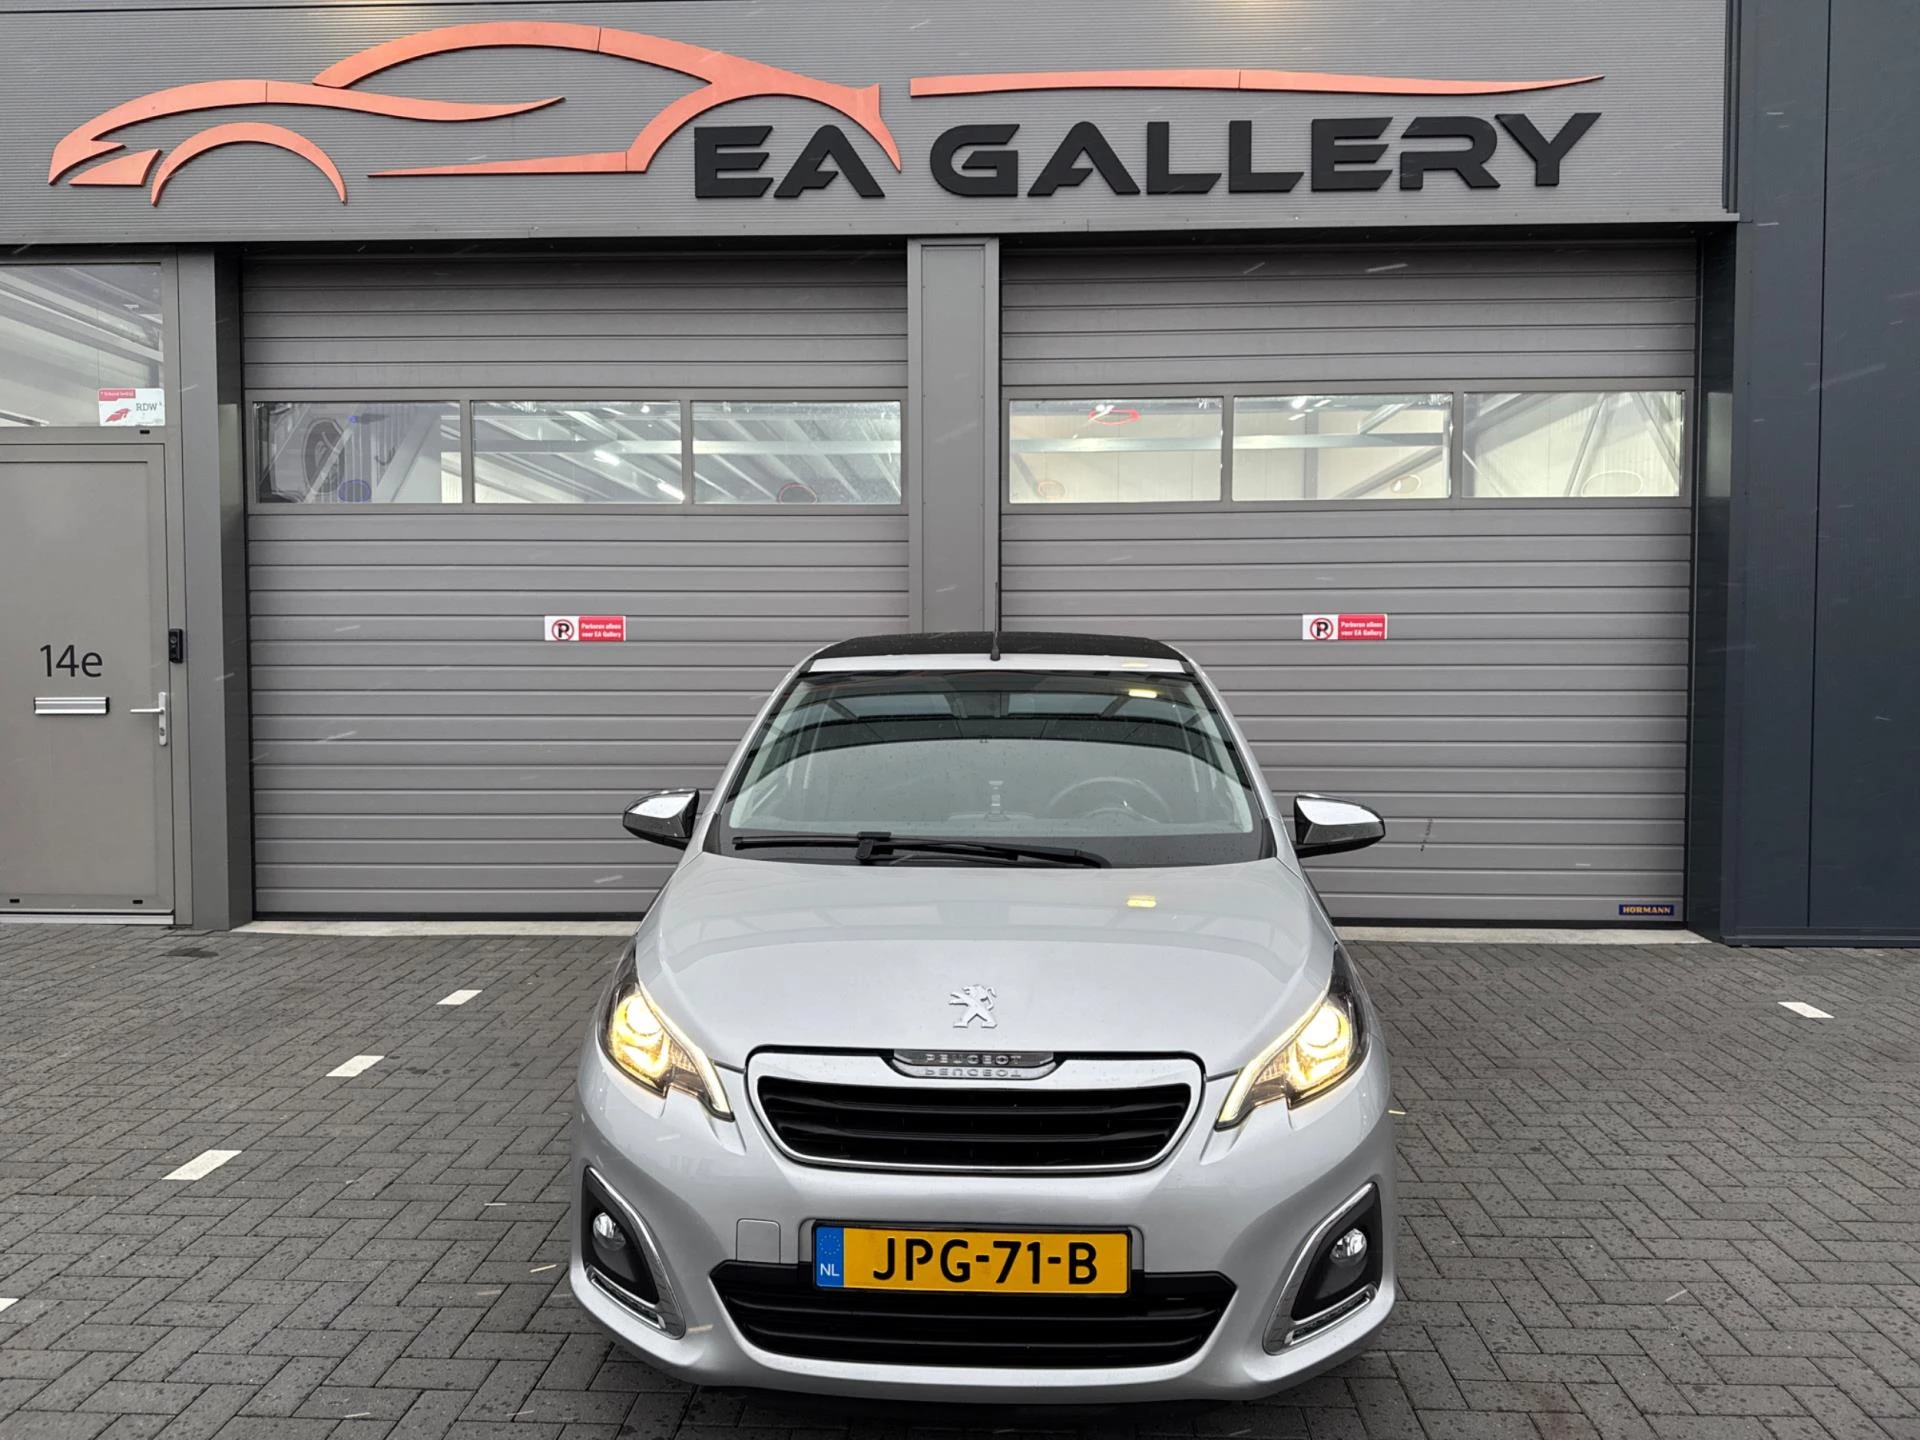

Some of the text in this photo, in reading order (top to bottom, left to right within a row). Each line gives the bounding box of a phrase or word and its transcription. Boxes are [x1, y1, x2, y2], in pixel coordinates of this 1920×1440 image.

[694, 112, 1602, 198] EA GALLERY
[136, 403, 157, 411] RDW
[603, 631, 621, 639] Gallery
[1363, 630, 1382, 638] Gallery
[40, 644, 103, 678] 14e
[925, 1053, 1021, 1065] PEUGEOT
[873, 1237, 1098, 1285] JPG-71-B
[820, 1263, 840, 1277] NL
